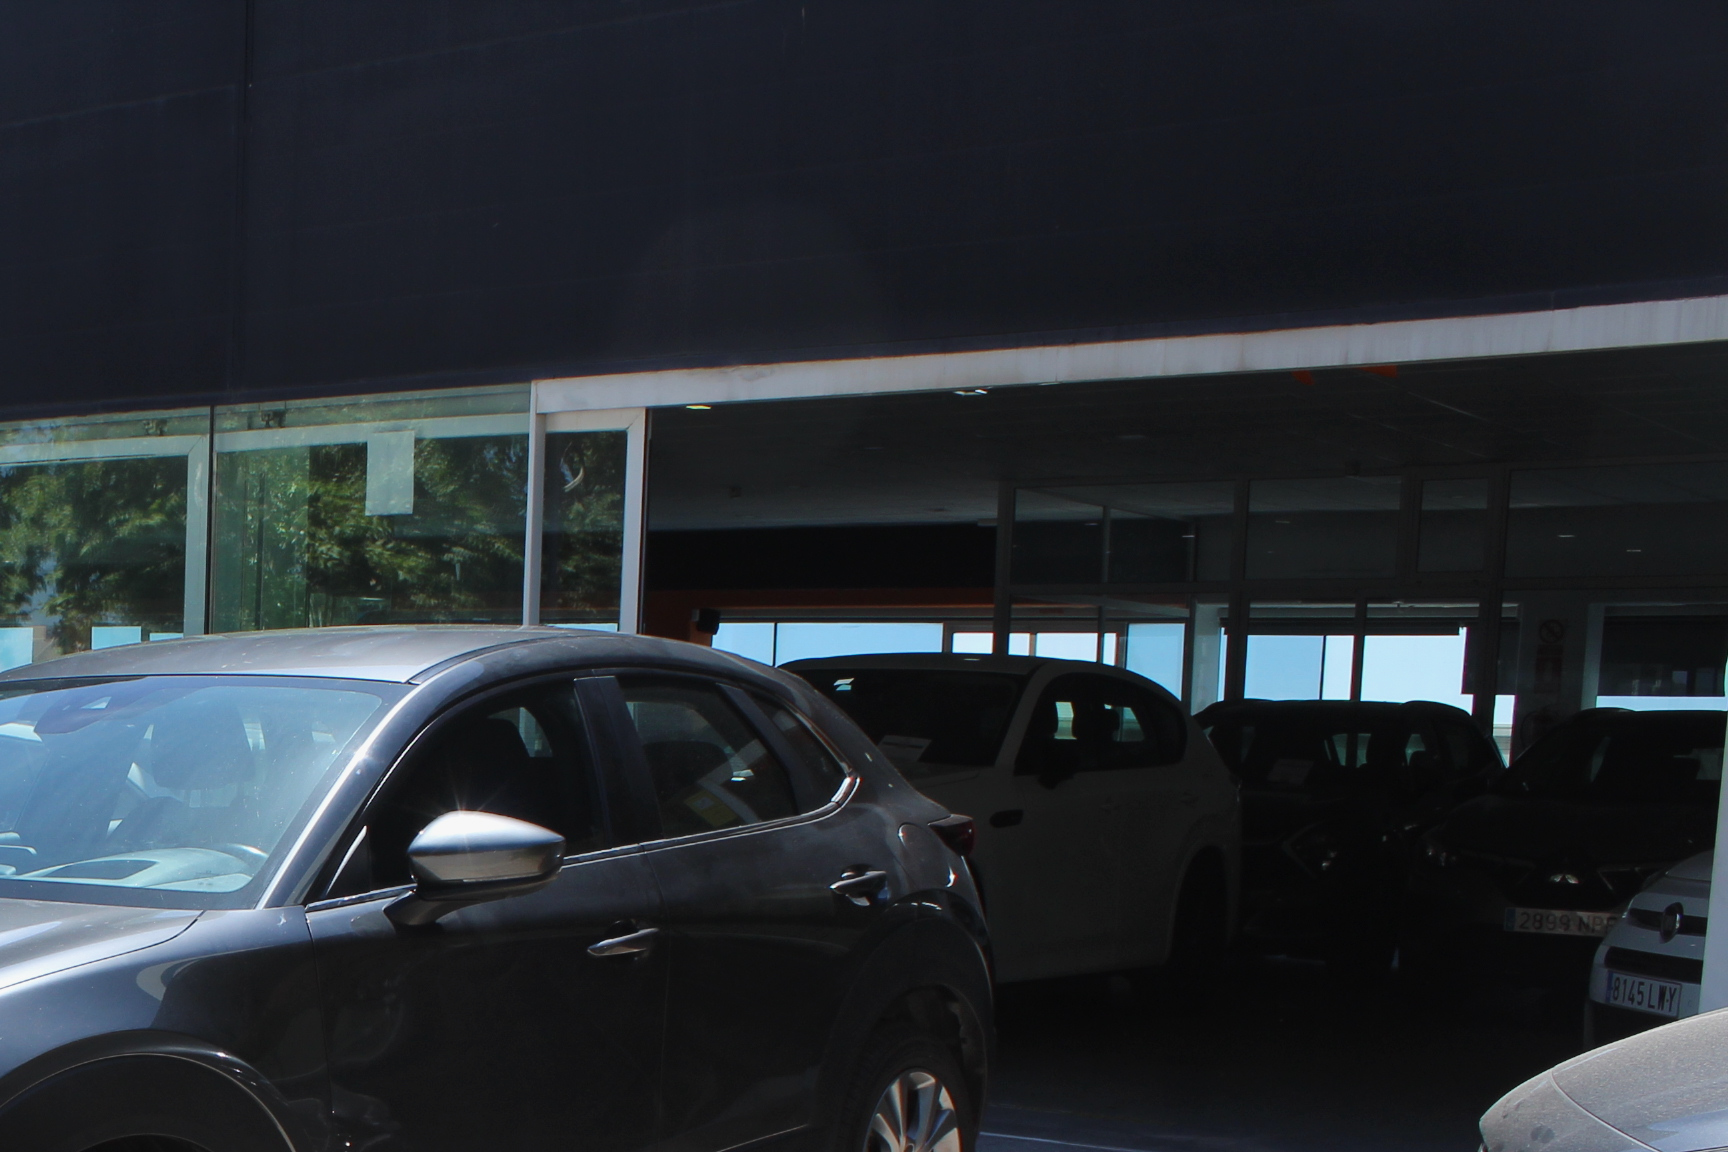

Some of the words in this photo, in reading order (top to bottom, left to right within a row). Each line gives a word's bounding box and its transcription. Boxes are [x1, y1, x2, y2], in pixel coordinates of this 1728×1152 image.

[1518, 911, 1570, 931] 2899
[1612, 976, 1645, 1006] 8145
[1647, 983, 1678, 1012] LWY
